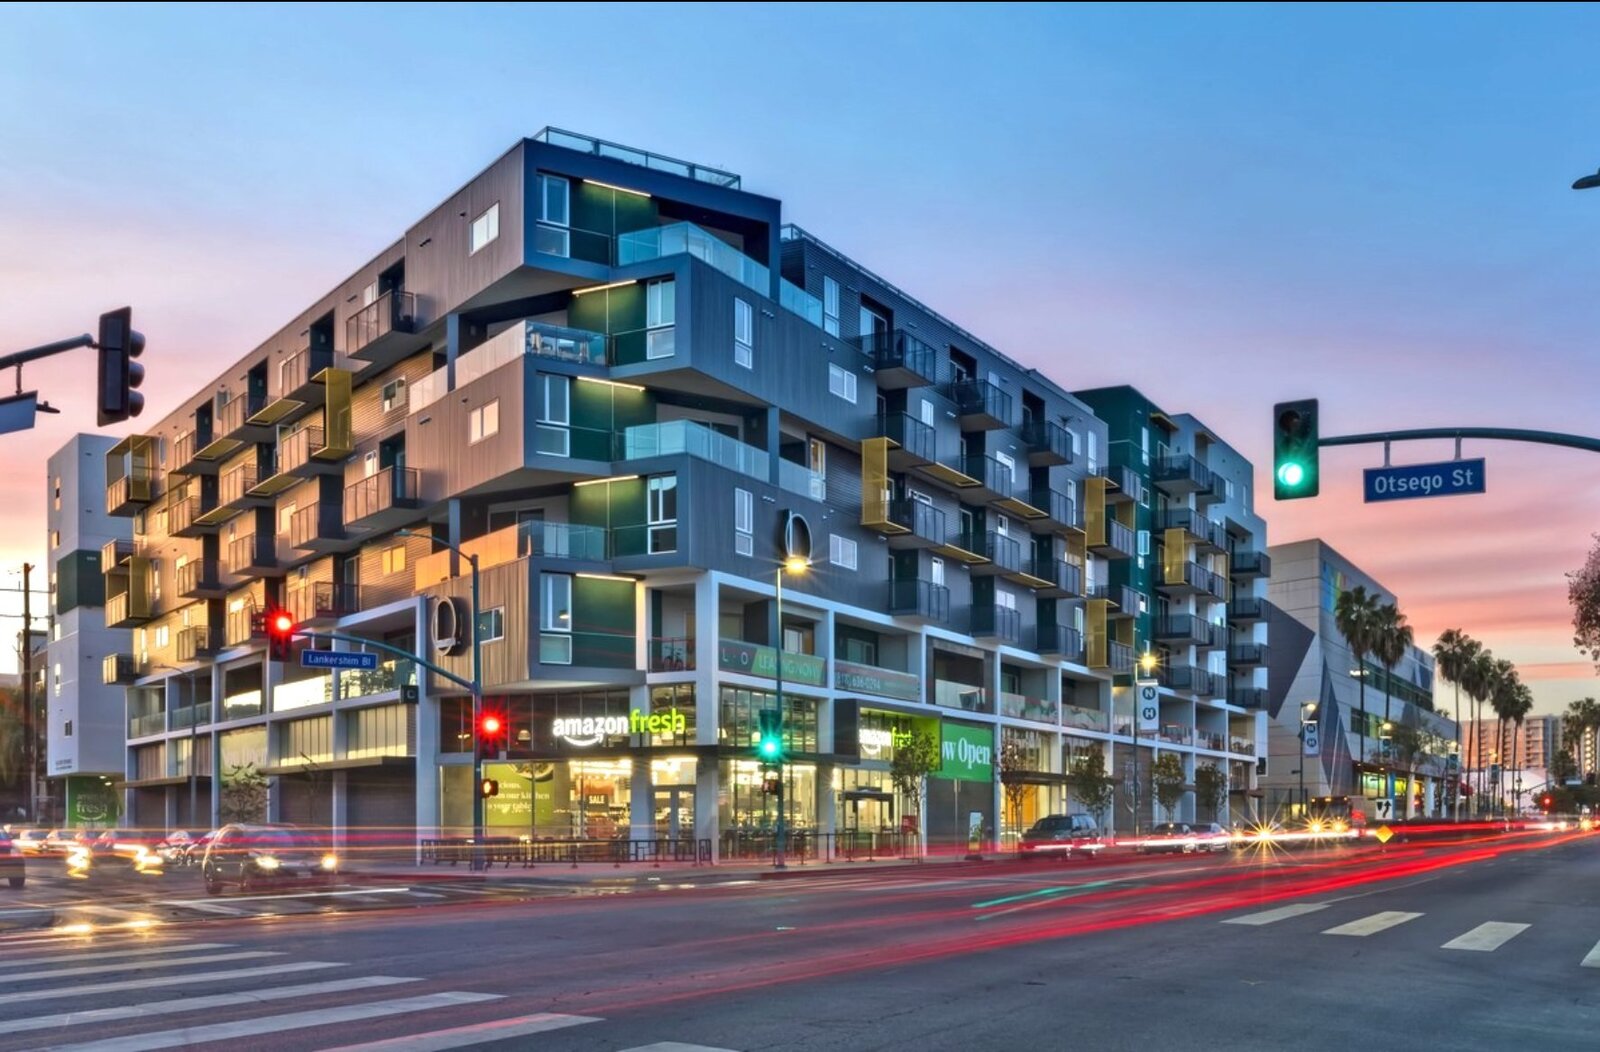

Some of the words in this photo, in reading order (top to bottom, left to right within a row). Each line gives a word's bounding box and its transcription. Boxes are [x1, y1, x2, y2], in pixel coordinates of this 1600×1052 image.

[1374, 475, 1443, 495] Otsego
[1452, 468, 1473, 487] St
[308, 654, 359, 665] Lankershim
[362, 657, 371, 666] Bl
[552, 716, 629, 737] amazon
[630, 707, 685, 734] fresh
[958, 737, 991, 770] Open
[588, 795, 605, 804] SALE
